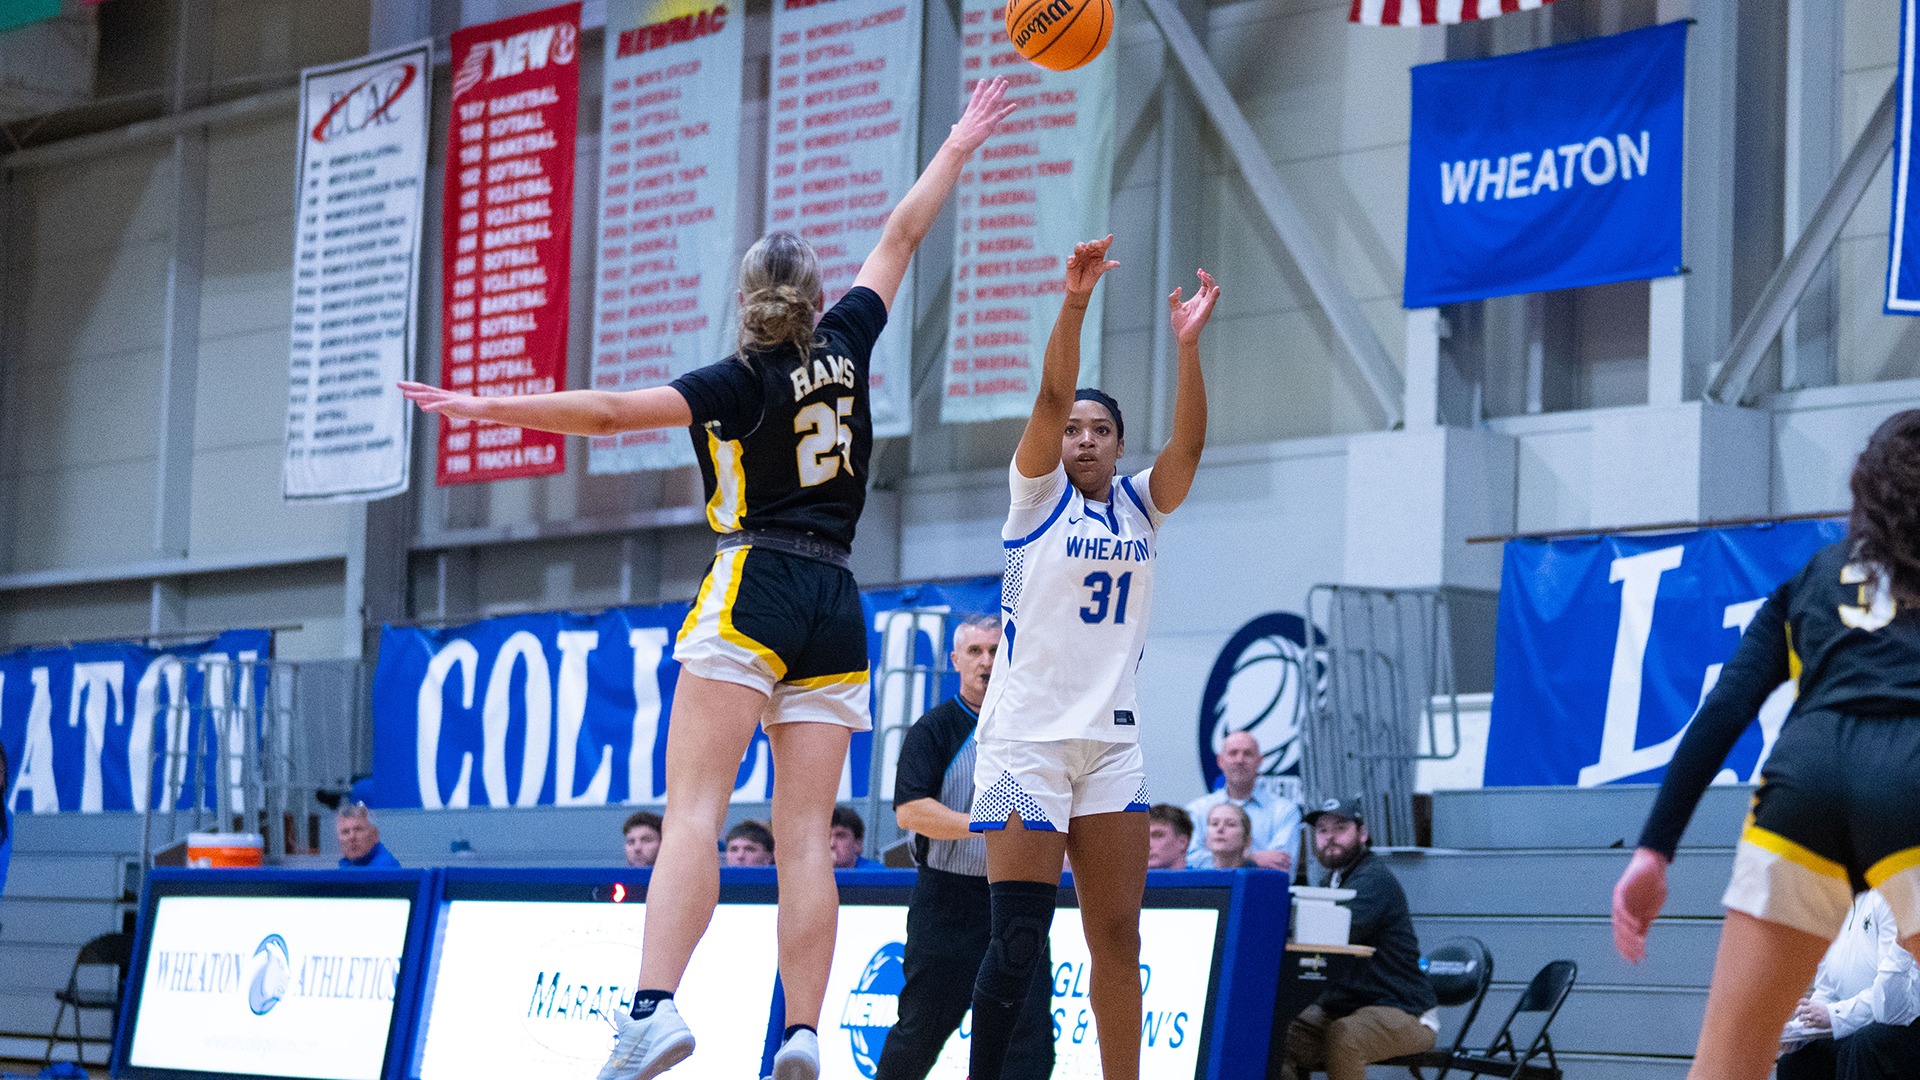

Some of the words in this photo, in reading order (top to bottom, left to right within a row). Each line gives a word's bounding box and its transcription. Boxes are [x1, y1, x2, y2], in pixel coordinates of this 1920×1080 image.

[1014, 0, 1073, 48] Wilson
[1440, 131, 1650, 205] WHEATON
[790, 355, 854, 402] RAMS
[794, 396, 854, 488] 25
[1066, 533, 1150, 562] WHEATON
[1079, 571, 1132, 625] 31
[0, 651, 258, 813] ATON
[156, 951, 247, 993] WHEATON
[295, 955, 401, 1002] ATHLETICS
